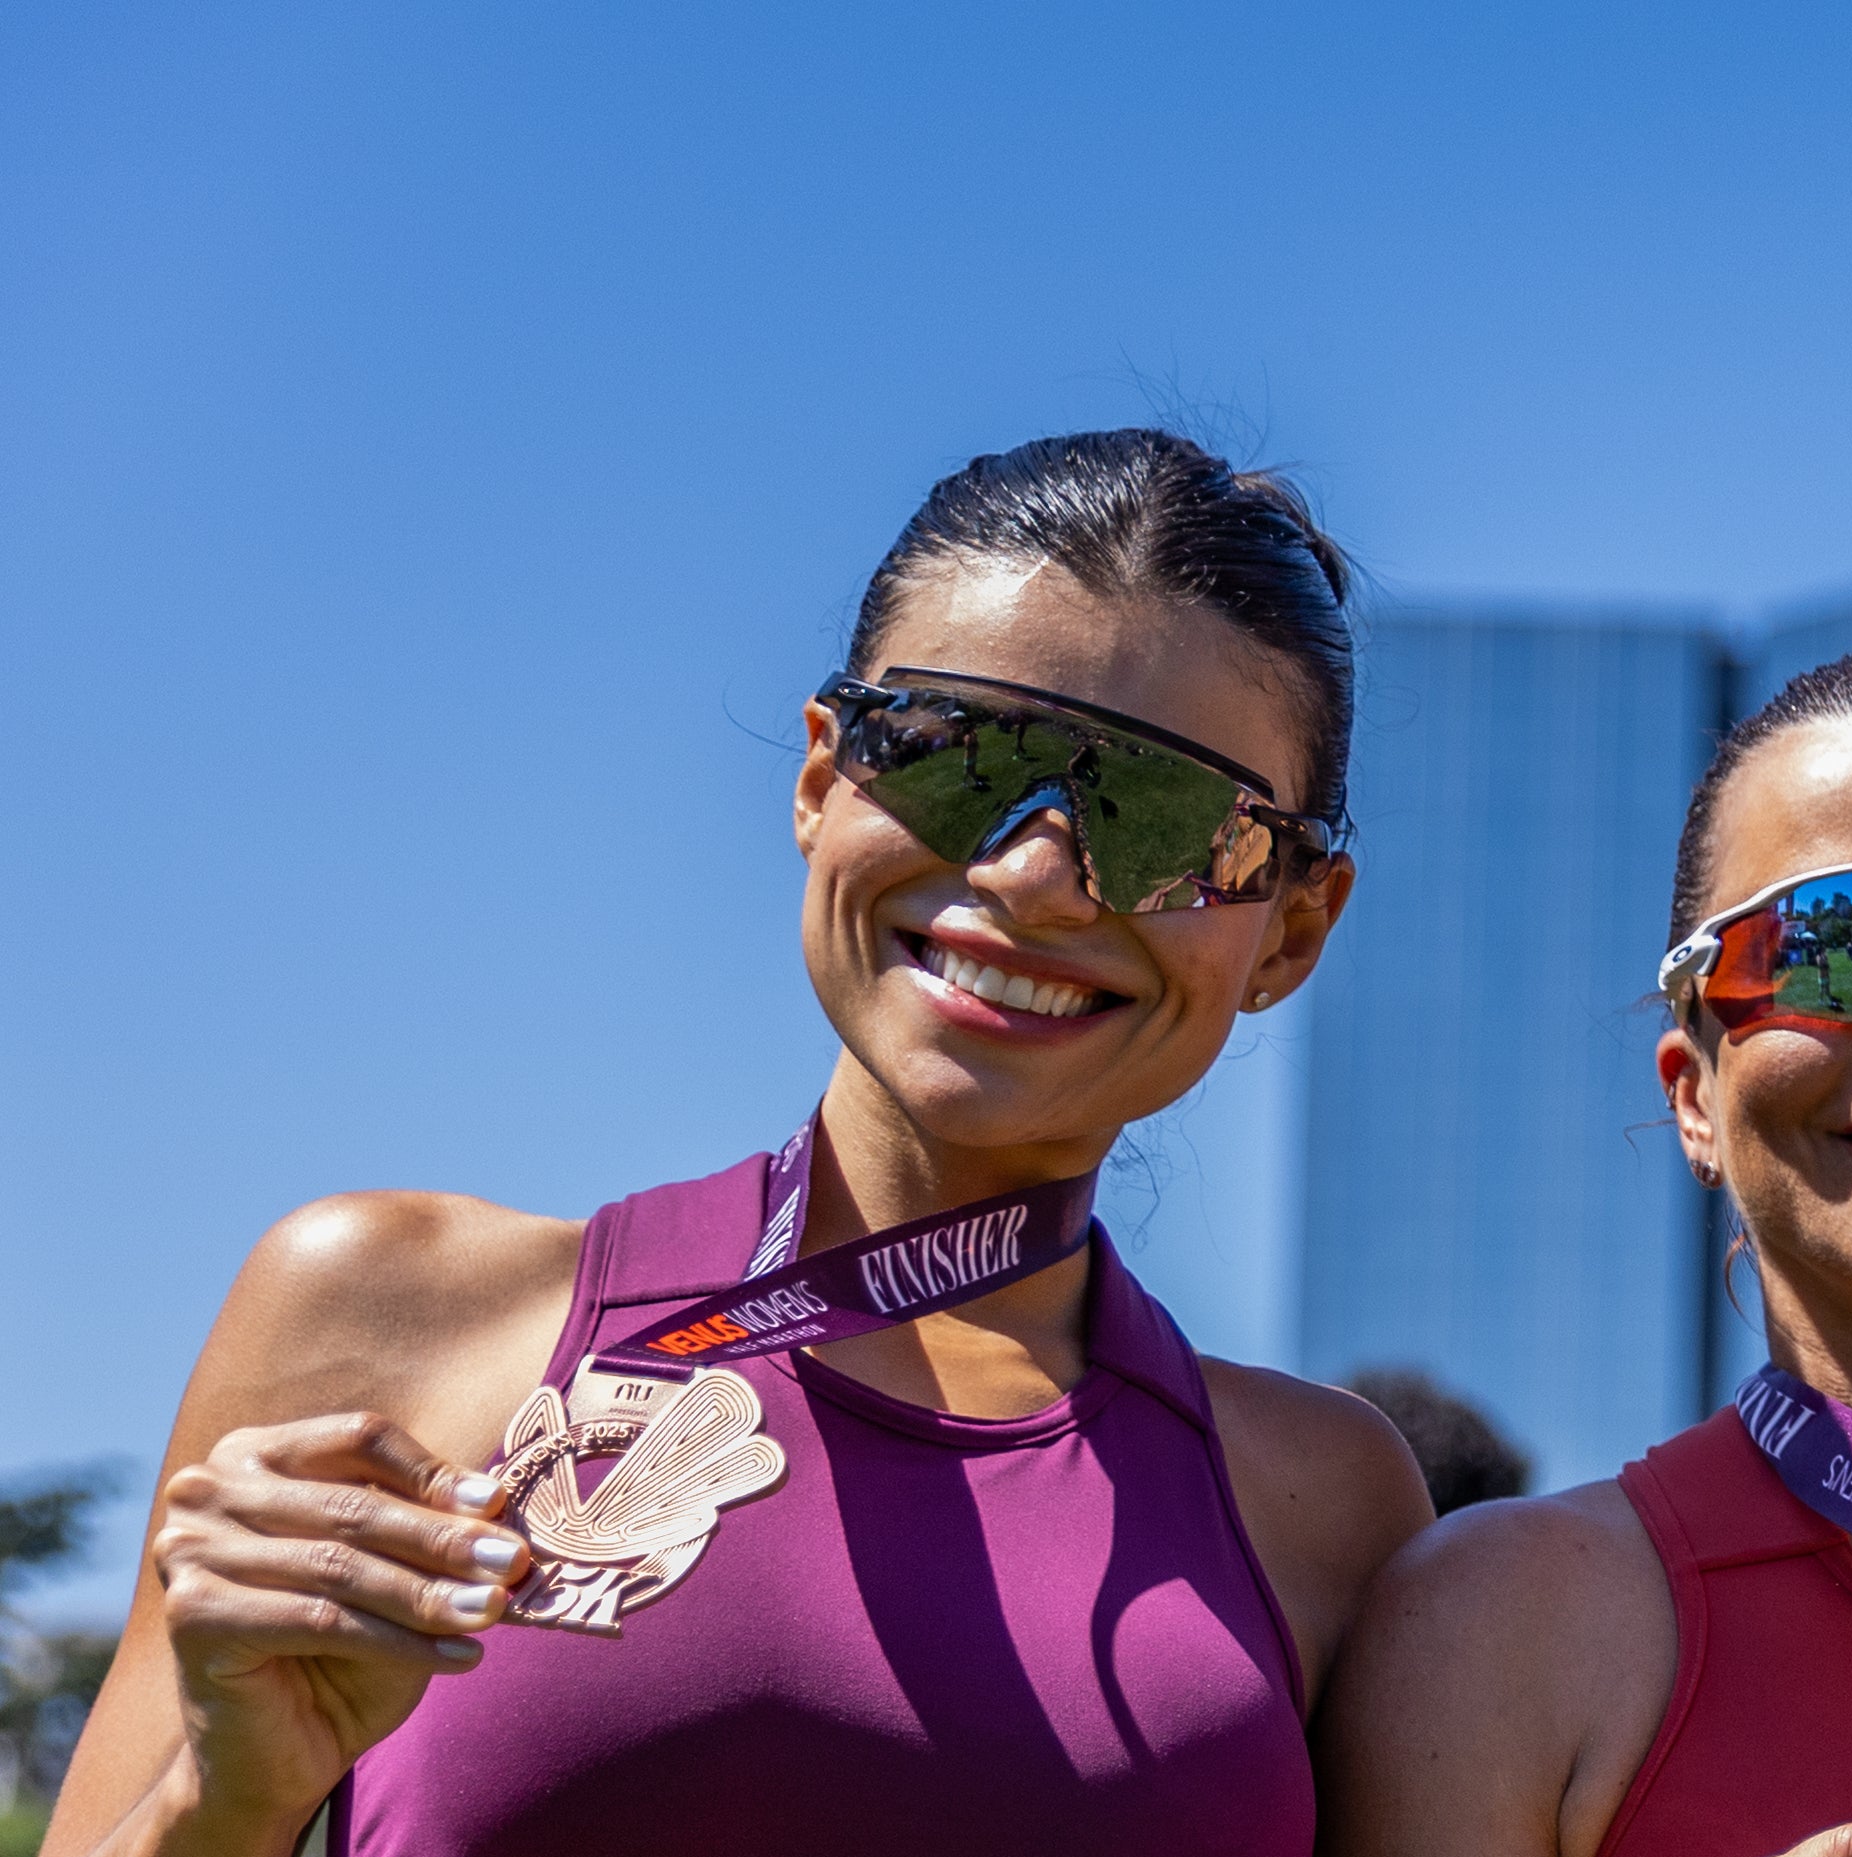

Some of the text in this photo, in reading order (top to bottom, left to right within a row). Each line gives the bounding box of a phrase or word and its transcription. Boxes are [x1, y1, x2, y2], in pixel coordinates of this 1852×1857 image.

[858, 1204, 1028, 1314] FINISHER
[758, 1323, 826, 1348] MARATHON
[583, 1424, 630, 1439] 2025
